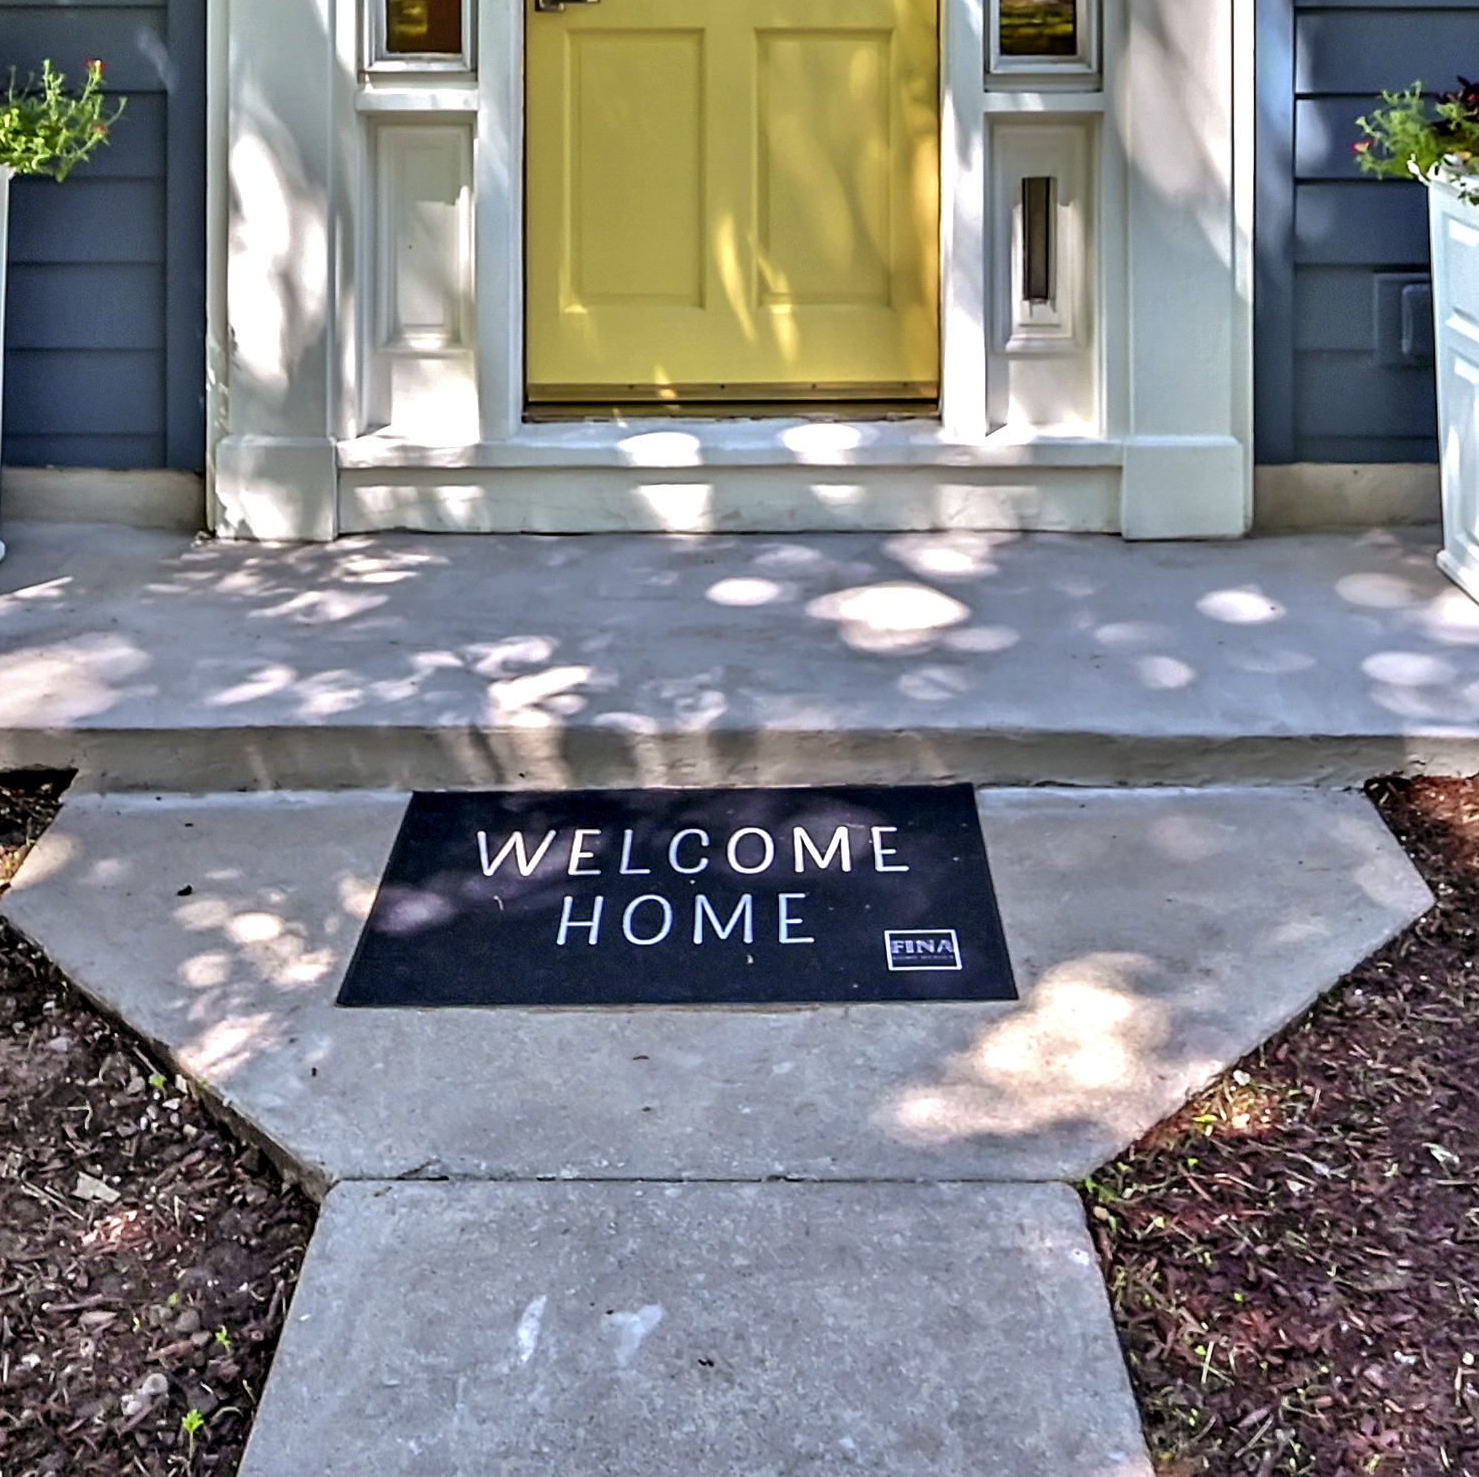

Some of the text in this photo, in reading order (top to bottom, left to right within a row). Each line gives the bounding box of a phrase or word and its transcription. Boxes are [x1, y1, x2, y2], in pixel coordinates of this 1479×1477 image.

[476, 825, 911, 877] WELCOME
[555, 892, 816, 947] HOME
[890, 939, 954, 954] FINA
